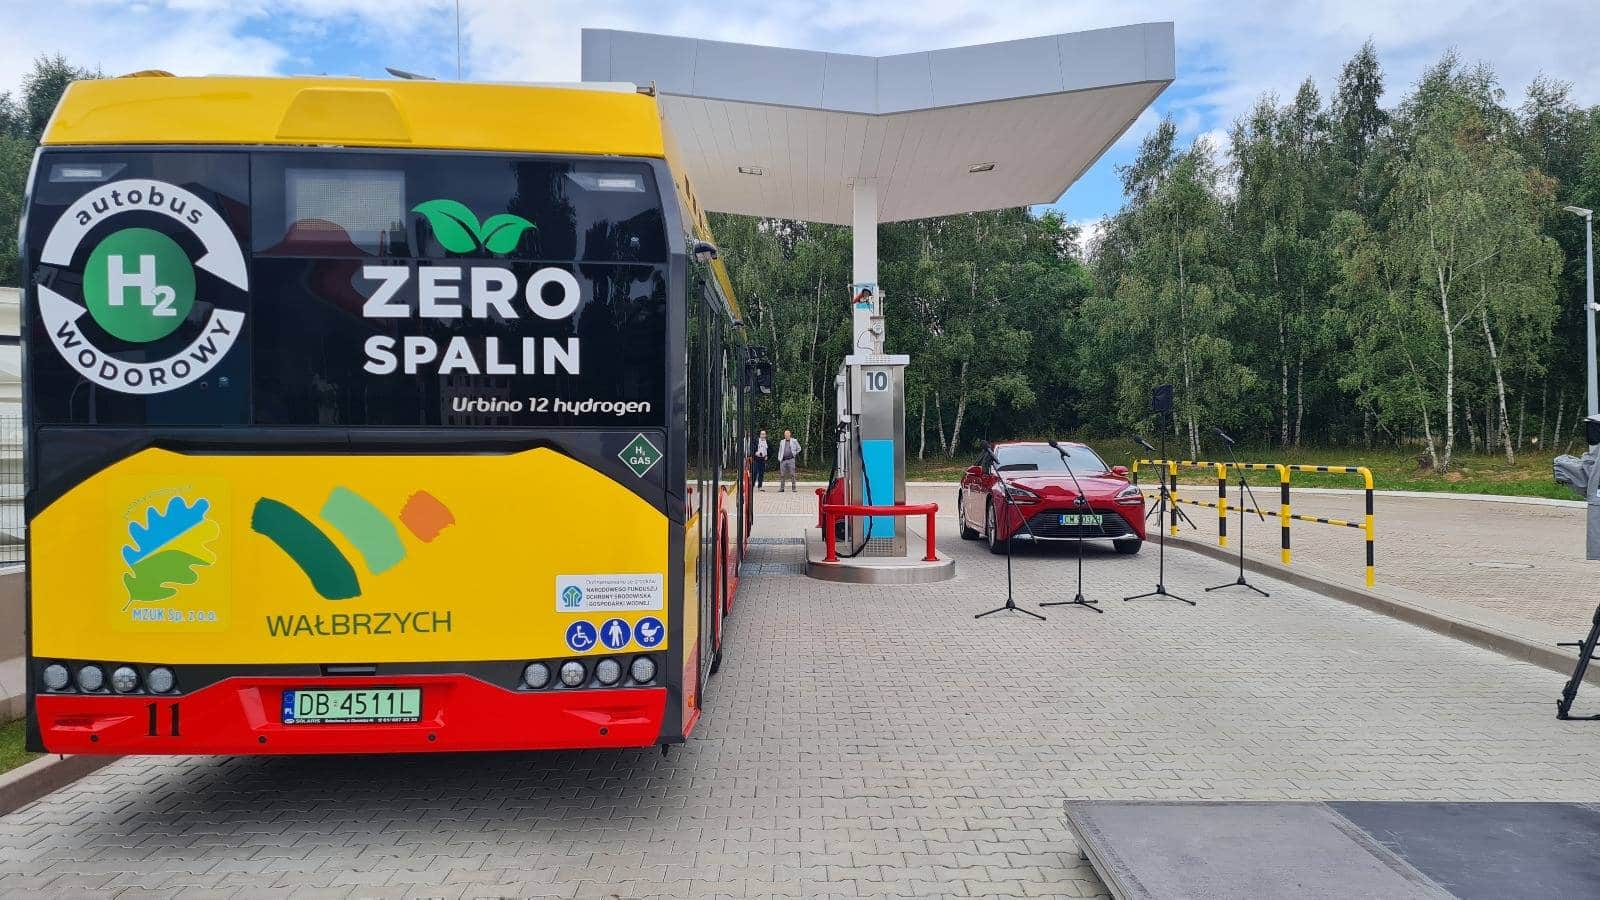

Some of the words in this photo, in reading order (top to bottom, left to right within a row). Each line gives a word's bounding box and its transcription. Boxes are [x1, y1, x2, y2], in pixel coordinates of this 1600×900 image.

[75, 186, 203, 226] autobus
[362, 266, 581, 320] ZERO
[56, 318, 231, 387] WODOROWY
[363, 335, 580, 375] SPALIN
[866, 372, 888, 391] 10
[452, 397, 523, 413] Urbino
[528, 397, 549, 413] 12
[553, 398, 651, 416] hydrogen
[630, 456, 651, 465] GAS
[133, 608, 165, 621] MZUK
[266, 611, 452, 637] WAŁBRZYCH
[300, 693, 330, 716] DB
[340, 692, 413, 715] 4511L
[144, 702, 184, 737] 11
